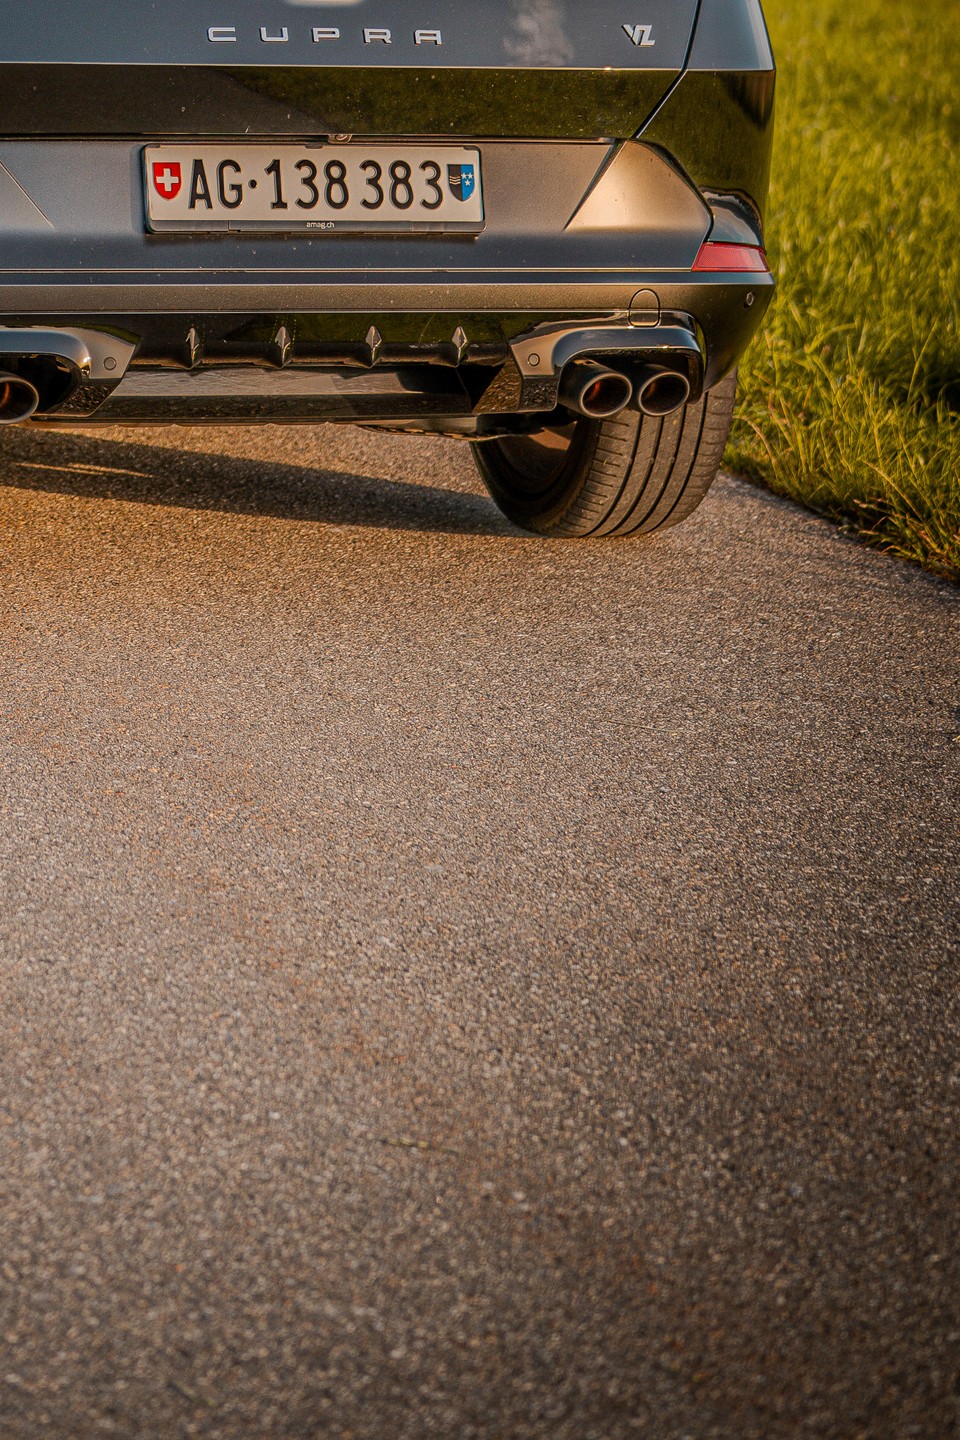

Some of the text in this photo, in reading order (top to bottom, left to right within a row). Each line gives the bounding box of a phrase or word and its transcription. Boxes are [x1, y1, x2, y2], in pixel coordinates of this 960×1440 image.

[207, 26, 443, 45] CUPRA
[621, 24, 656, 47] VZ
[359, 160, 444, 209] 383
[306, 221, 335, 229] amag.ch
